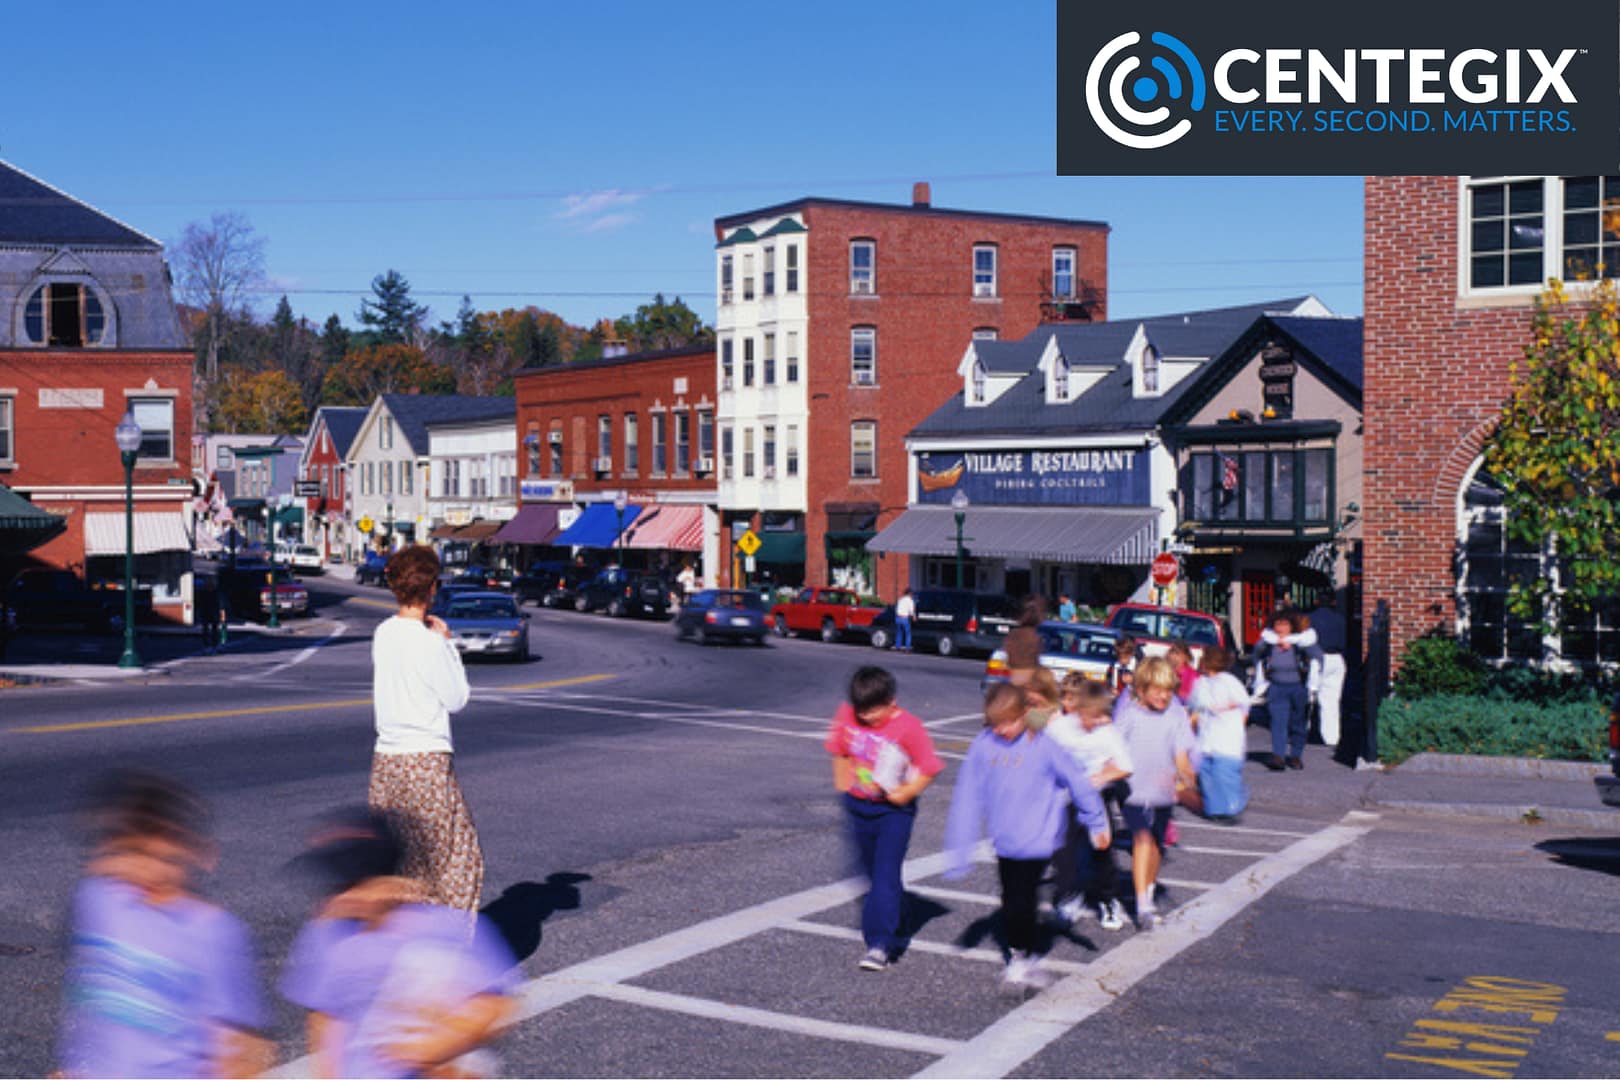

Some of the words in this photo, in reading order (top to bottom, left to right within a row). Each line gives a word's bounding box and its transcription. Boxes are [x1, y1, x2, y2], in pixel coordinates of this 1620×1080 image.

[966, 453, 1023, 473] VILLAGE
[1031, 450, 1136, 474] RESTAURANT
[1152, 562, 1177, 575] STOP
